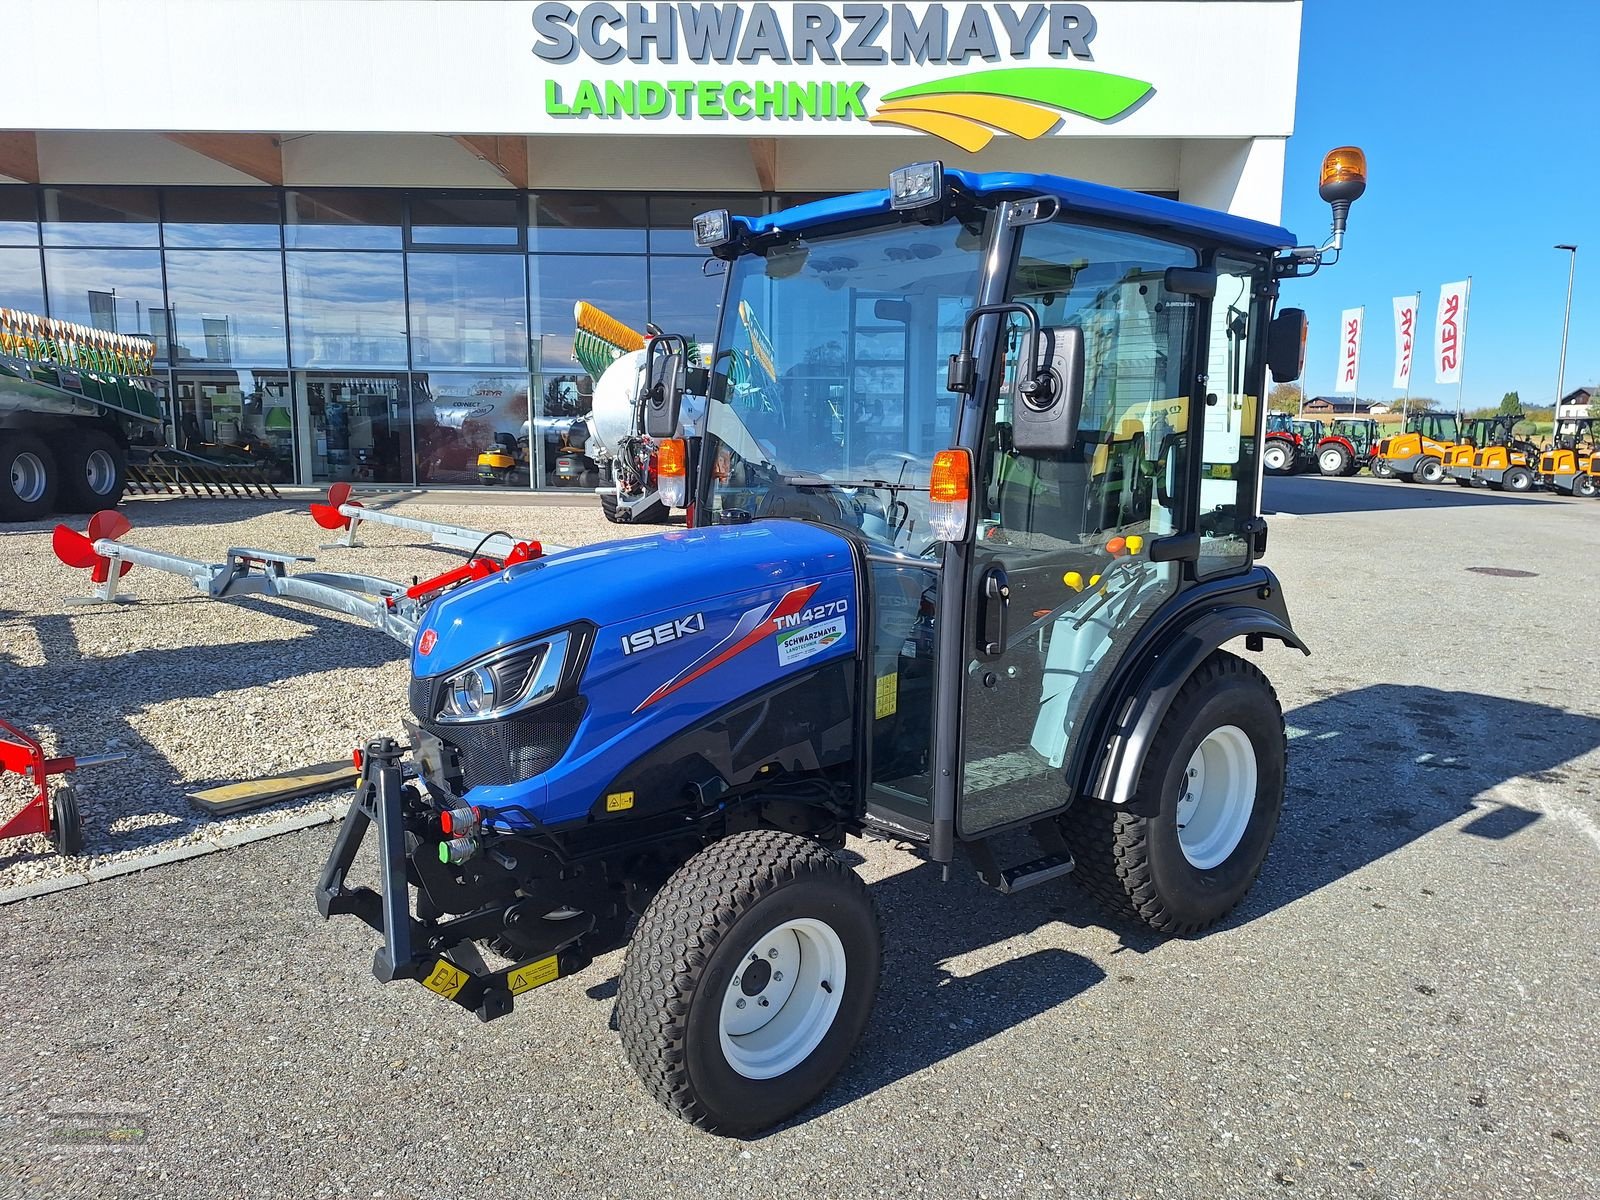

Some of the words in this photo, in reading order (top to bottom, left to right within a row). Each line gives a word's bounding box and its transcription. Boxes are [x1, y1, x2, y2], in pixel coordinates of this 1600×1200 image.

[531, 1, 1096, 65] SCHWARZMAYR
[544, 79, 869, 119] LANDTECHNIK
[620, 611, 706, 656] ISEKI
[784, 625, 837, 648] SCHWARZMAYR
[785, 640, 818, 654] LANDTECHNIK
